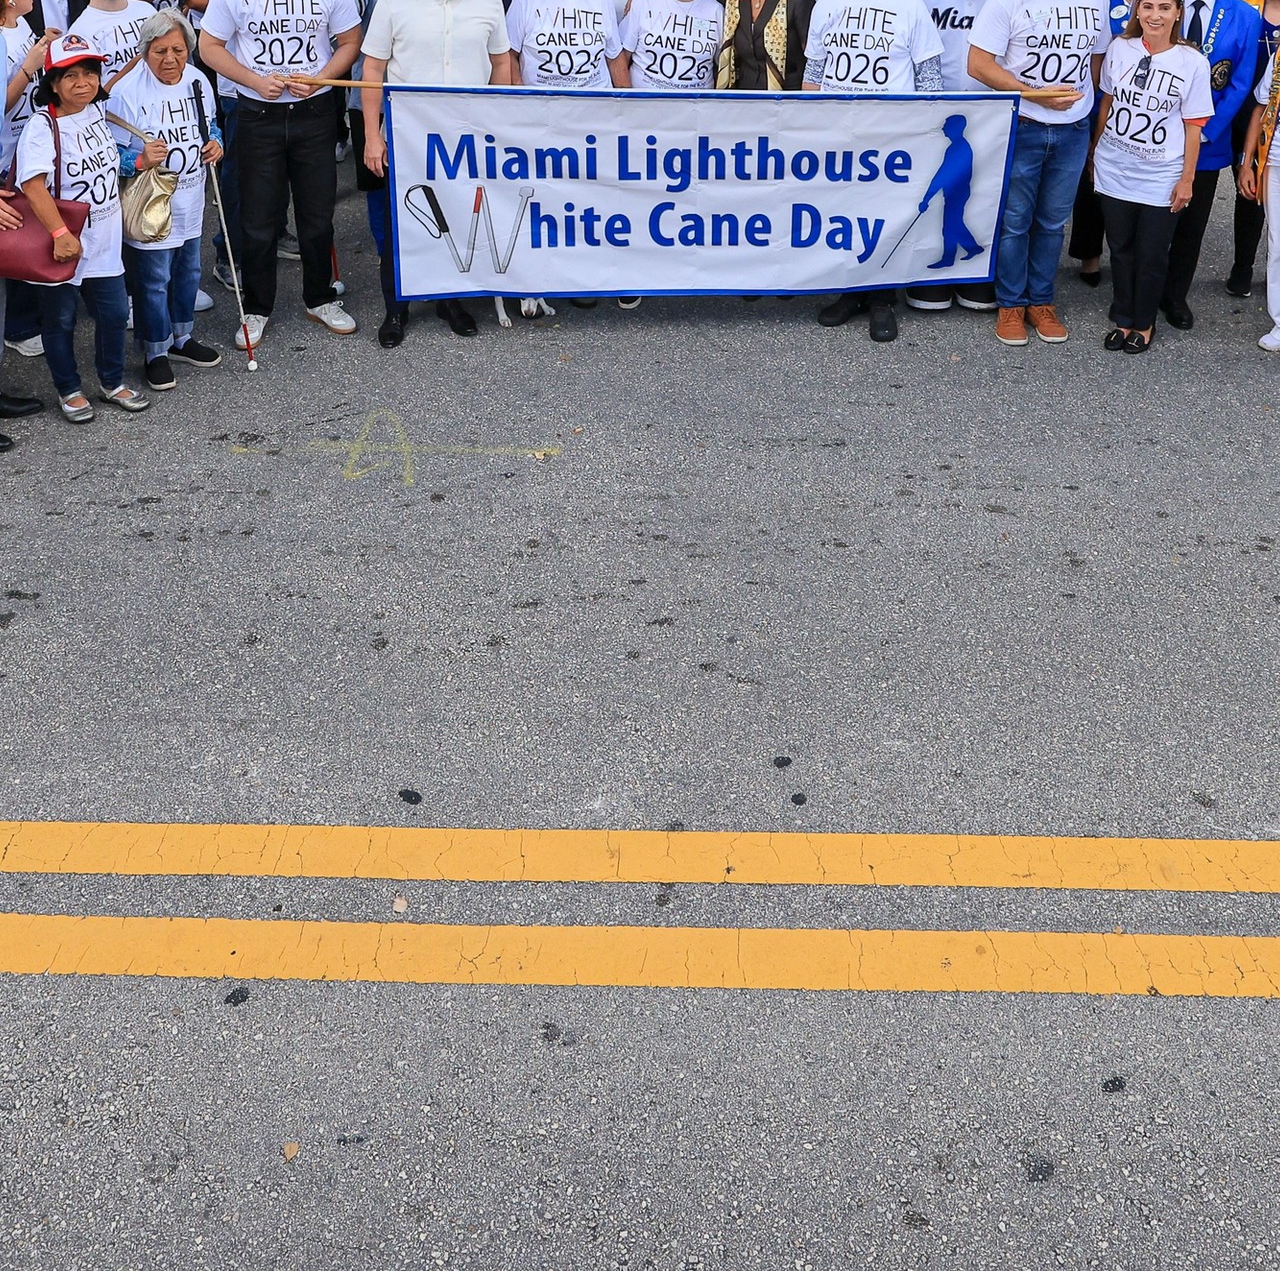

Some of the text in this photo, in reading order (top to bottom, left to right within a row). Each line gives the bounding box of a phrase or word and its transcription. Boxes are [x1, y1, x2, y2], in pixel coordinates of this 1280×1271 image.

[248, 18, 322, 35] CANE DAY
[534, 6, 603, 32] WHITE
[930, 7, 975, 31] Mia
[253, 34, 318, 67] 2026
[535, 32, 578, 47] CANE
[644, 33, 687, 52] CANE
[823, 32, 895, 53] CANE DAY
[1026, 33, 1070, 50] CANE
[644, 49, 712, 81] 2026
[1146, 95, 1181, 114] DAY
[66, 150, 106, 178] CANE
[424, 132, 913, 193] Miami Lighthouse
[404, 183, 886, 274] White Cane Day
